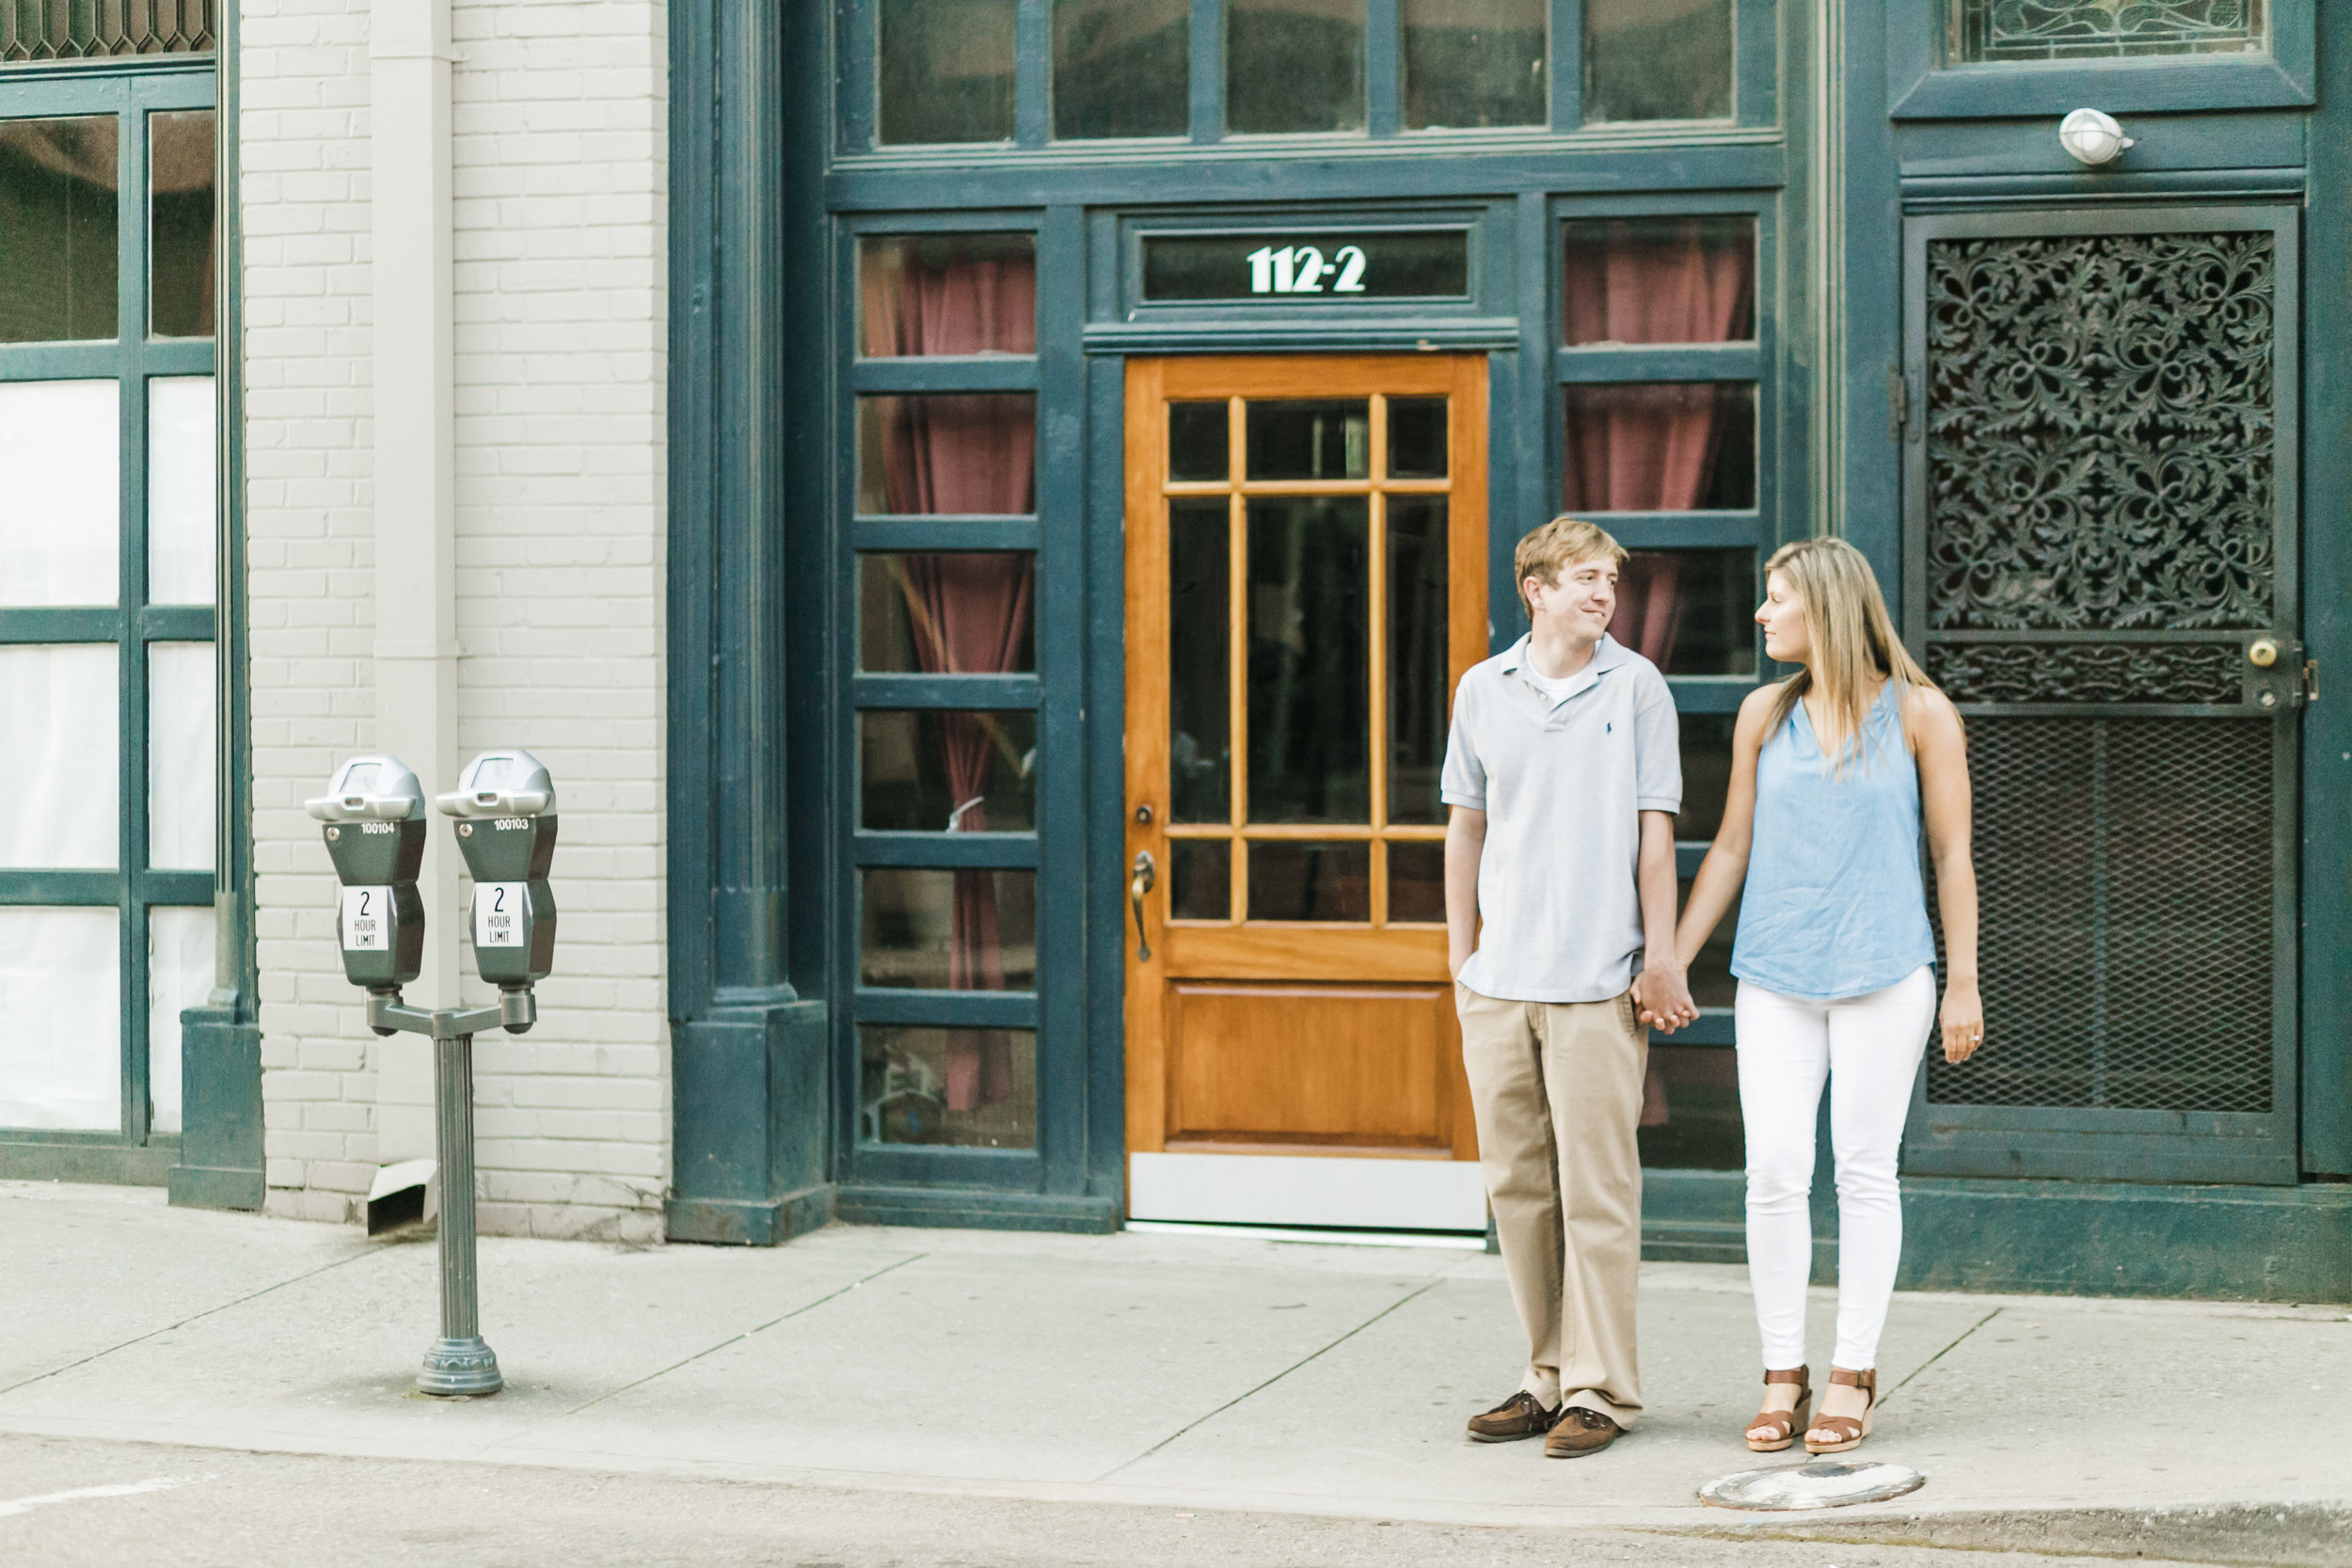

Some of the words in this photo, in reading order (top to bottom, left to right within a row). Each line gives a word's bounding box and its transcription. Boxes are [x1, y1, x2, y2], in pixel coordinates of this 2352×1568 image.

[1246, 245, 1367, 293] 112-2
[360, 821, 395, 834] 100104
[493, 817, 529, 832] 100103
[360, 891, 371, 916] 2
[494, 887, 505, 912] 2
[354, 919, 376, 932] HOUR
[487, 915, 511, 928] HOUR
[356, 934, 375, 947] LIMIT
[489, 930, 510, 943] LIMIT
